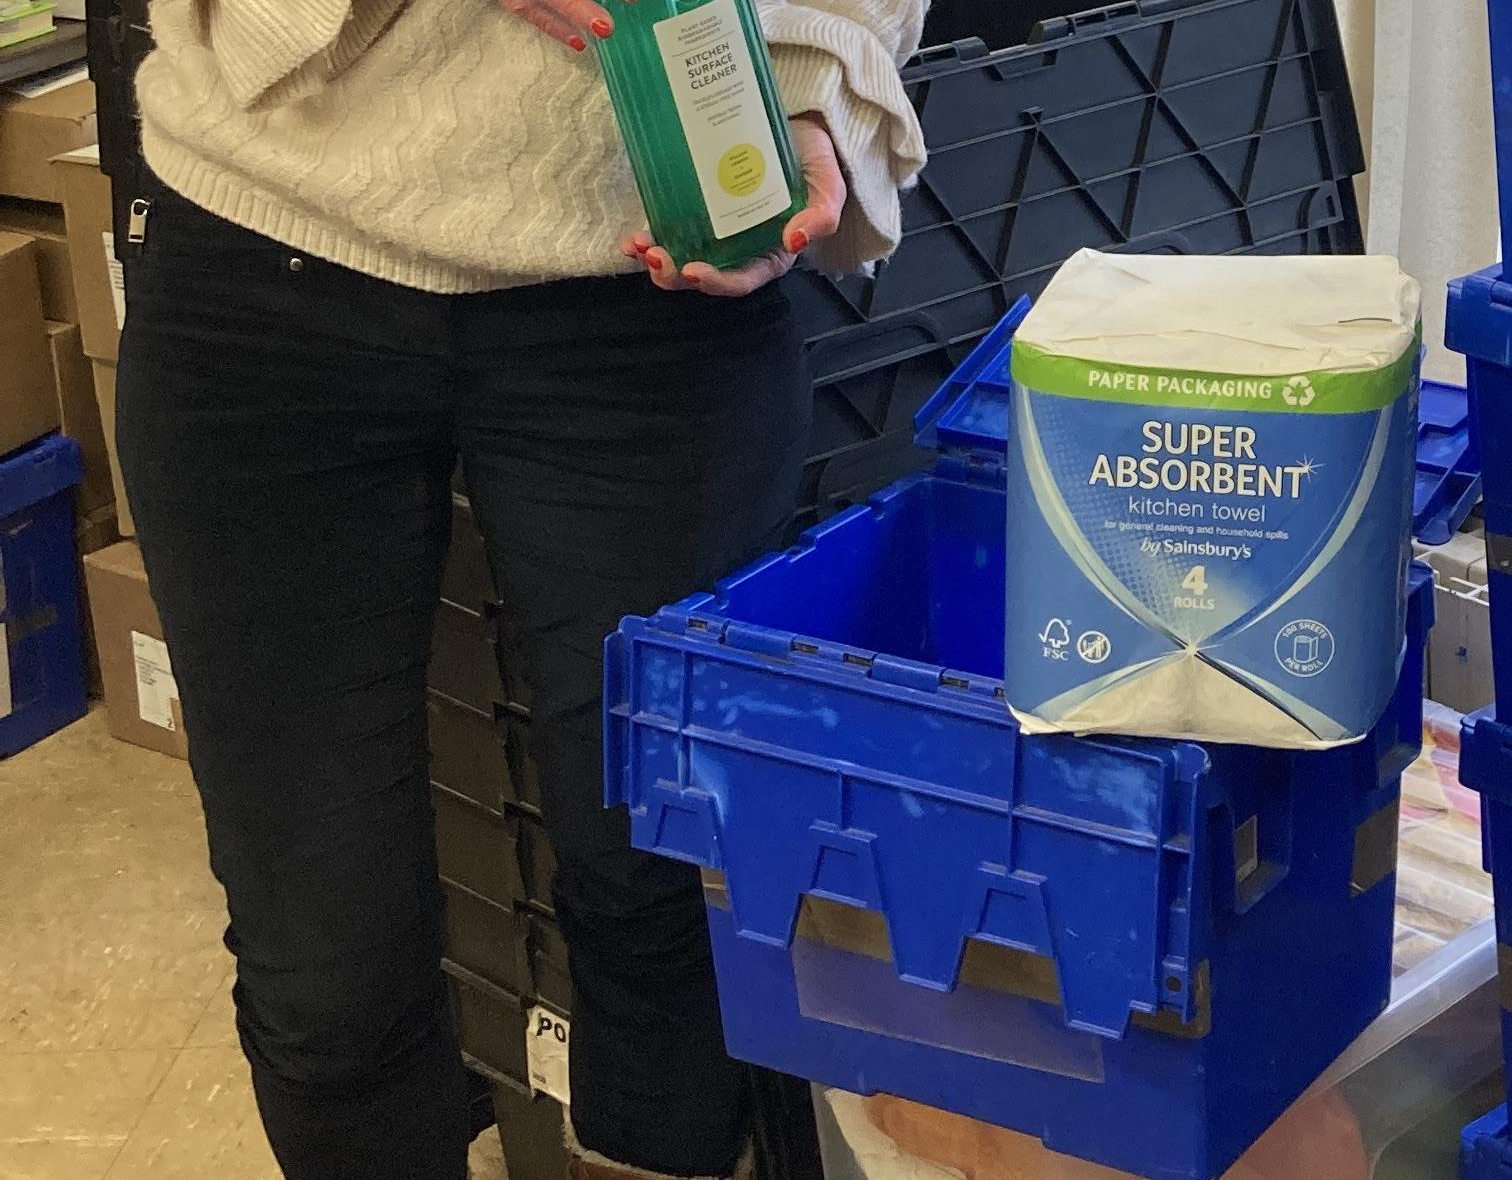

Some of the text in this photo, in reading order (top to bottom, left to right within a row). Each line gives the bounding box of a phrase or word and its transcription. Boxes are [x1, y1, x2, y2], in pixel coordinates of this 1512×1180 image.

[685, 41, 730, 68] KITCHEN
[688, 52, 733, 79] SURFACE
[691, 63, 737, 90] CLEANER
[1088, 370, 1273, 399] PAPER PACKAGING
[1142, 420, 1257, 460] SUPER
[1087, 453, 1310, 500] ABSORBENT
[1128, 496, 1267, 523] kitchen towel
[1104, 520, 1289, 541] for general cleaning and household spills
[1140, 536, 1252, 561] by Sainsbury's
[1181, 565, 1209, 596] 4
[1173, 597, 1215, 610] ROLLS
[1042, 647, 1069, 661] FSC
